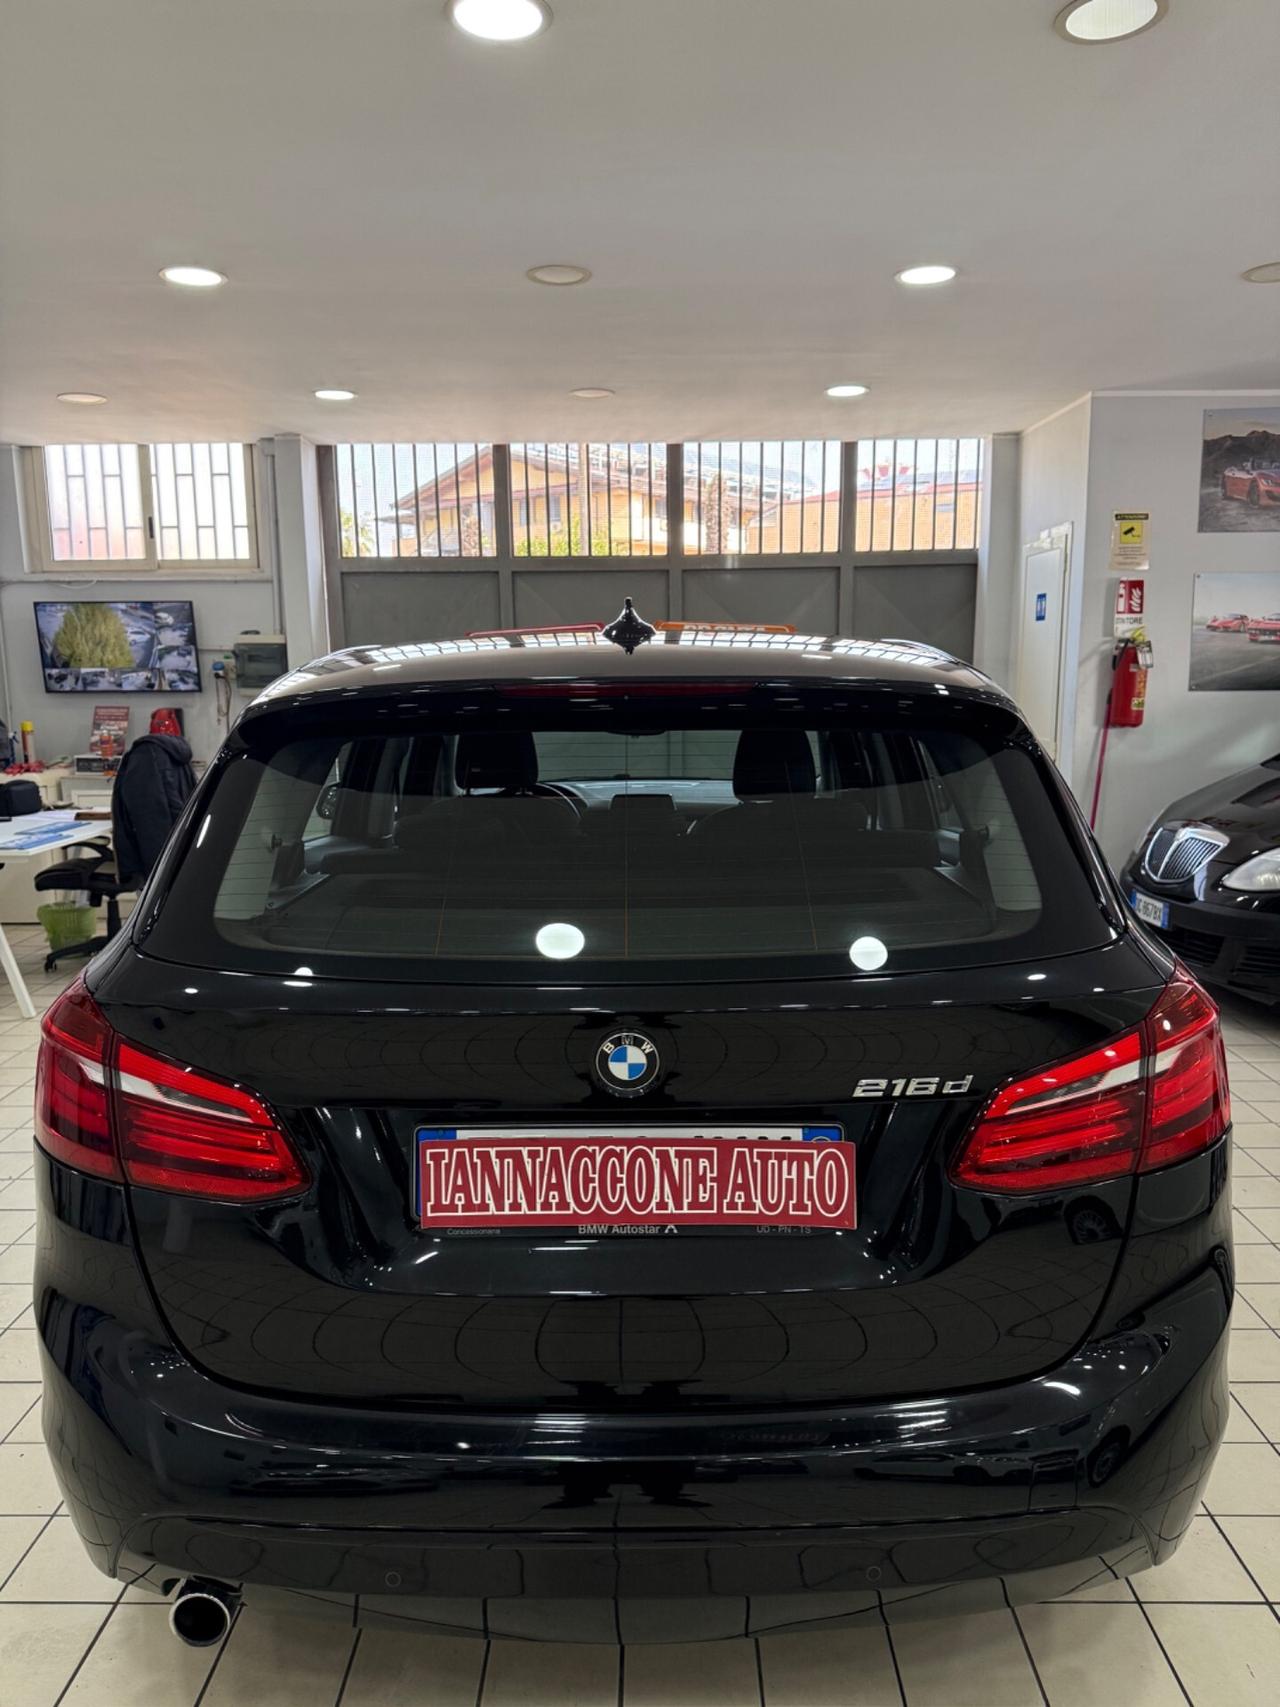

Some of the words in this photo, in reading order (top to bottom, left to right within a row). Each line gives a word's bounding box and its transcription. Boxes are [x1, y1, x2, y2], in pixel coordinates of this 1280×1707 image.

[602, 1035, 654, 1054] BMW
[852, 1074, 974, 1098] 216d
[426, 1145, 718, 1217] IANNACCONE
[722, 1148, 849, 1218] AUTO
[578, 1224, 609, 1234] BMW
[611, 1224, 660, 1234] Autostar
